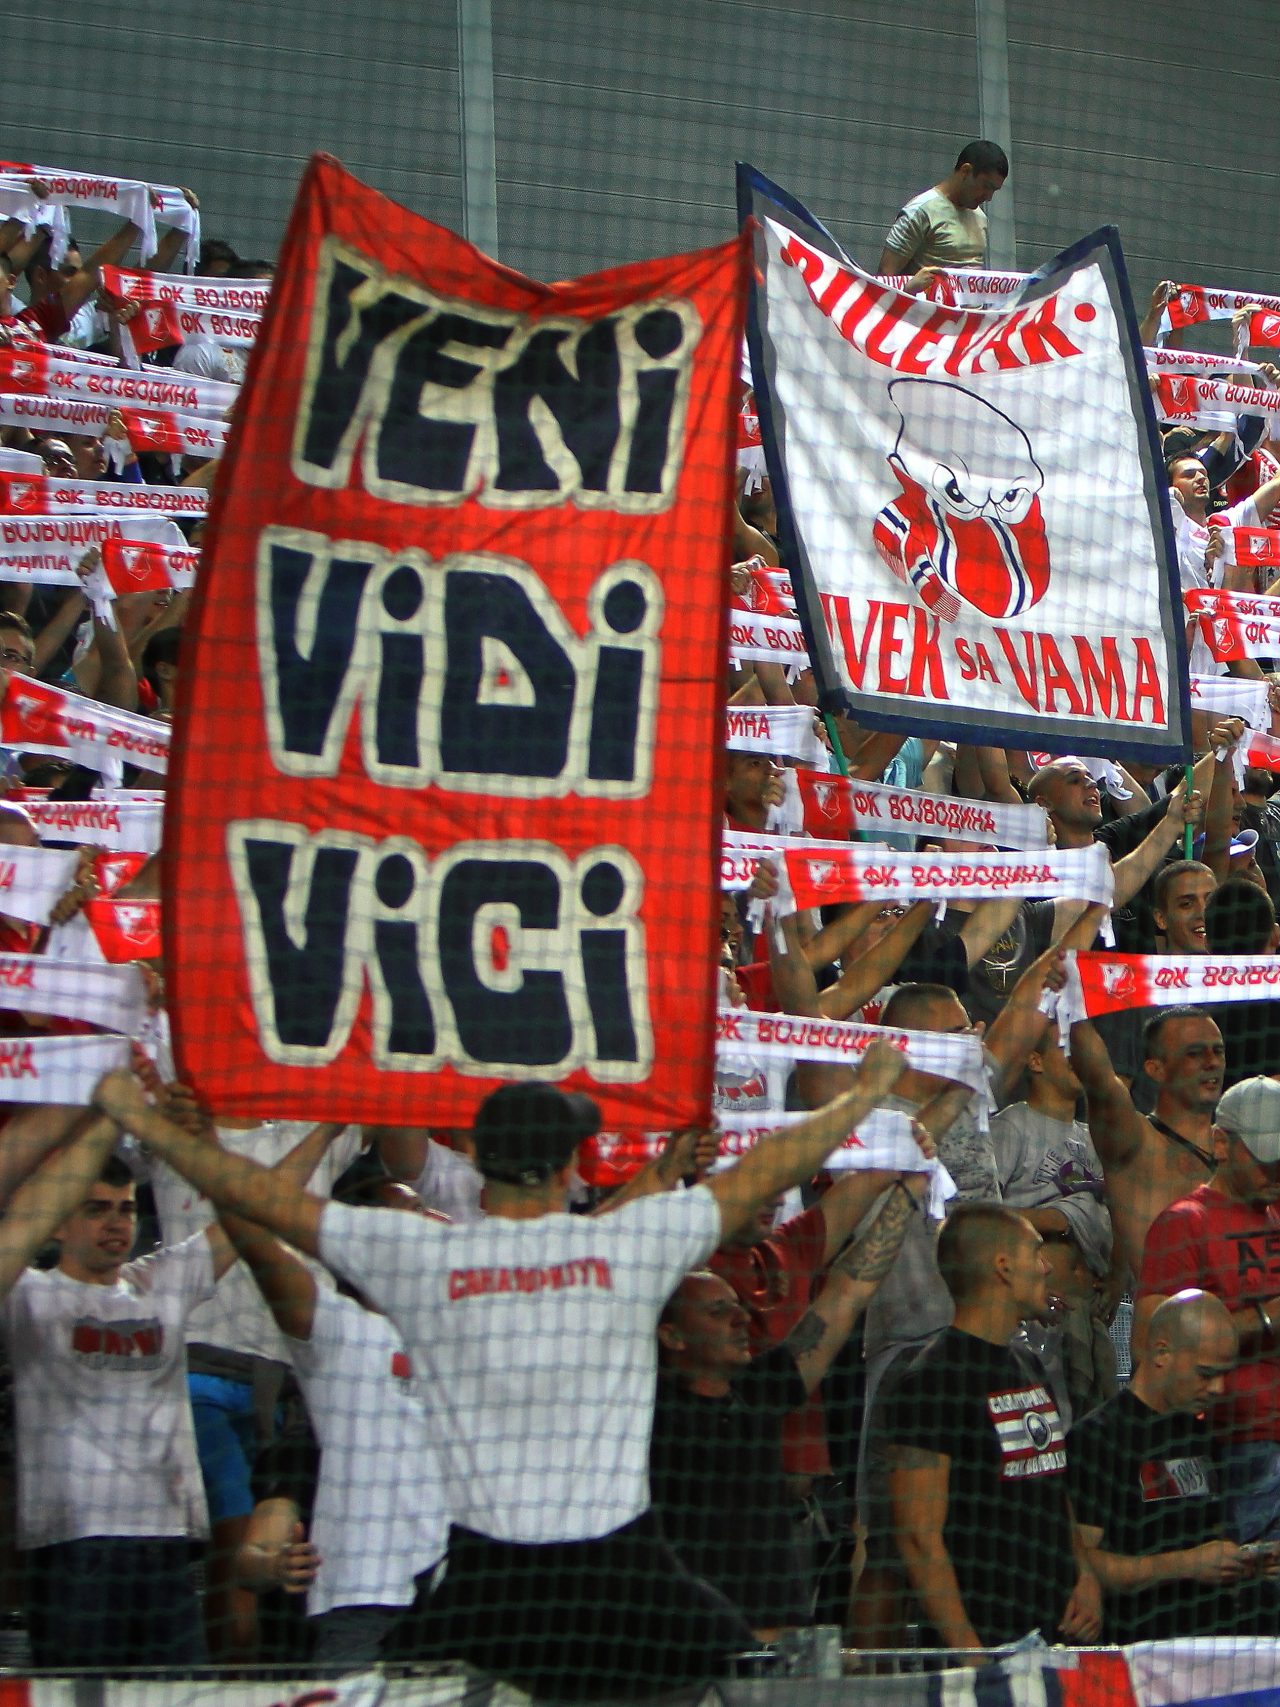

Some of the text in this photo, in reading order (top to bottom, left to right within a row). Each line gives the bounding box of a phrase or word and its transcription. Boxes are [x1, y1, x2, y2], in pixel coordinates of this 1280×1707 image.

[41, 177, 118, 200] ЈВОДИНА
[967, 275, 1019, 294] ВОЈВОД
[159, 287, 270, 312] ФК ВОЈВОД
[1207, 293, 1229, 310] ФК
[180, 312, 258, 338] ФК ВОЈВО
[50, 371, 199, 409] ФК ВОЈВОДИНА
[1198, 383, 1220, 400] ФК
[13, 399, 110, 425] ВОЈВОДИН
[182, 426, 214, 447] ФК
[54, 488, 208, 512] ФК ВОЈВОДИН
[3, 518, 124, 546] ВОЈВОДИНА
[1237, 599, 1264, 616] ФК
[1245, 621, 1270, 644] ФК
[819, 592, 1167, 725] VEK SA VAMA
[854, 791, 997, 834] ФК ВОЈВОДИНА
[862, 864, 1060, 890] ФК ВОЈВОДИНА
[1155, 967, 1193, 988] ФК
